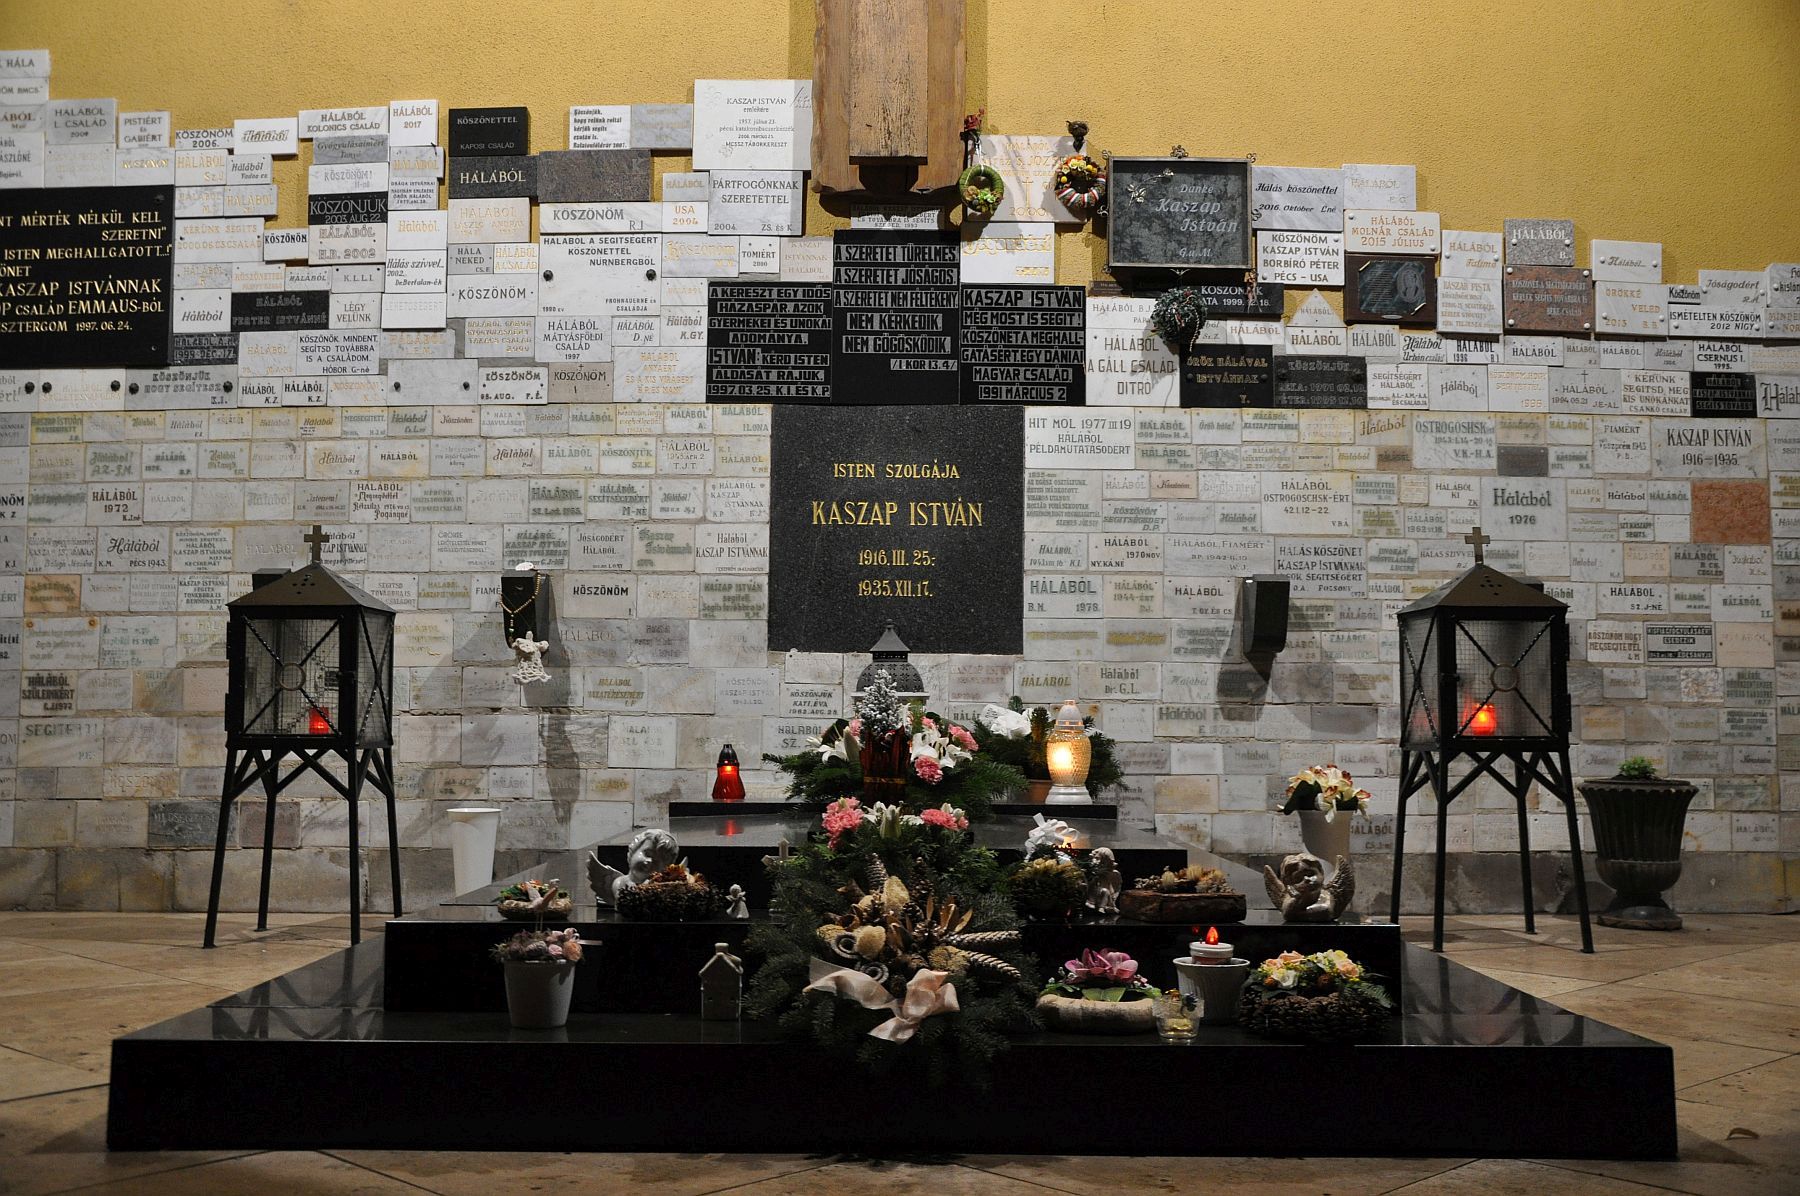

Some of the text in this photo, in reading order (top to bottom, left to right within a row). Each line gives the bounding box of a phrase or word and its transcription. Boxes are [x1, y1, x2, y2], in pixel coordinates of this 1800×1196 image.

[321, 111, 366, 122] HÁLÁBÓL
[393, 106, 432, 116] HÁLÁBÓL
[176, 129, 233, 139] KÖSZÖNÖM
[307, 122, 380, 133] KOLONICS CSALÁD
[460, 170, 526, 184] HÁLÁBÓL
[713, 178, 798, 190] PÁRTFOGÓNKNAK
[1256, 183, 1337, 195] Hálás köszönettel
[722, 194, 788, 204] SZERETETTEL
[1156, 198, 1221, 214] Kaszap
[21, 210, 161, 226] MÉRTÉK NÉLKÜL KELL
[553, 208, 624, 220] KÖSZÖNÖM
[1371, 216, 1415, 225] HÁLÁBÓL
[1180, 218, 1237, 232] István
[1272, 232, 1328, 243] KÖSZÖNÖM
[1352, 227, 1392, 237] MOLNÁR
[1398, 228, 1434, 237] CSALÁD
[1513, 226, 1568, 240] HÁLÁBÓL
[1361, 238, 1424, 247] 2015 JÚLIUS
[5, 248, 39, 259] ISTEN
[834, 242, 958, 262] A SZERETET TÜRELMES.
[1263, 246, 1338, 256] KASZAP ISTVÁN
[1263, 257, 1338, 269] BORBÍRÓ PÉTER
[835, 264, 956, 285] A SZERETET JÓSÁGOS.
[1274, 271, 1328, 282] PÉCS USA
[69, 275, 161, 295] ISTVÁNNAK
[459, 288, 526, 300] KÖSZÖNÖM
[710, 288, 718, 298] A
[722, 288, 775, 298] KERESZT
[778, 288, 800, 298] EGY
[834, 291, 842, 307] A
[844, 291, 889, 307] SZERETET
[891, 291, 908, 307] NEM
[965, 287, 1082, 307] KASZAP ISTVÁN
[16, 300, 164, 315] CSALÁD EMMAUS-BÓL
[344, 301, 366, 312] LÉGY
[719, 300, 822, 314] HÁZASPÁR. AZOK
[182, 311, 222, 321] Hálából
[337, 312, 371, 323] VELÜNK
[710, 314, 831, 328] GYERMEKEI ÉS UNOKÁI
[850, 310, 942, 330] NEM KÉRKEDIK.
[964, 308, 1039, 325] MÉG MOST IS
[1670, 311, 1761, 322] ISMÉTELTEN KÖSZÖNÖM
[76, 322, 98, 331] 1997.
[101, 321, 116, 330] 06.
[117, 321, 132, 330] 24.
[548, 319, 598, 331] HÁLÁBÓL
[962, 327, 1020, 345] KÖSZÖNET
[1022, 330, 1028, 344] A
[1292, 330, 1341, 346] HÁLÁBÓL
[555, 342, 590, 350] CSALÁD
[844, 337, 871, 352] NEM
[1105, 334, 1158, 352] HÁLÁBÓL
[1403, 336, 1442, 350] Hálából
[1699, 342, 1742, 352] HÁLÁBÓL
[1021, 349, 1041, 362] EGY
[1044, 346, 1084, 363] DÁNIAI
[1513, 343, 1556, 357] HÁLÁBÓL
[762, 351, 790, 365] KÉRD
[794, 354, 828, 365] ISTEN
[1697, 353, 1738, 362] CSERNUS
[1088, 357, 1174, 374] A GÁLL CSALÁD
[716, 367, 771, 380] ÁLDÁSÁT
[973, 365, 1072, 382] MAGYAR CSALÁD.
[285, 381, 324, 392] HÁLÁBÓL
[979, 383, 1065, 400] 1991 MÁRCIUS 2
[1118, 377, 1150, 395] DITRÓ
[1441, 382, 1478, 397] Hálából
[1029, 418, 1047, 428] HIT
[1053, 418, 1076, 428] MOL
[1081, 418, 1106, 429] 1977
[1120, 419, 1131, 429] 19
[1668, 427, 1751, 447] KASZAP ISTVÁN
[380, 451, 418, 460] HÁLÁBÓL
[834, 458, 960, 479] ISTEN SZOLGÁJA
[92, 488, 137, 501] HÁLÁBÓL
[1493, 488, 1551, 506] Hálából
[104, 504, 129, 513] 1972
[812, 496, 983, 527] KASZAP ISTVÁN
[1509, 515, 1536, 525] 1976
[107, 538, 159, 554] Hálából
[1104, 535, 1149, 547] HÁLÁBÓL
[859, 550, 890, 566] 1916.
[892, 550, 909, 566] III.
[573, 585, 628, 596] KÖSZÖNÖM
[858, 580, 892, 596] 1935.
[895, 580, 916, 596] XII.
[1030, 576, 1097, 594] HÁLÁBÓL
[1175, 584, 1224, 597] HÁLÁBÓL
